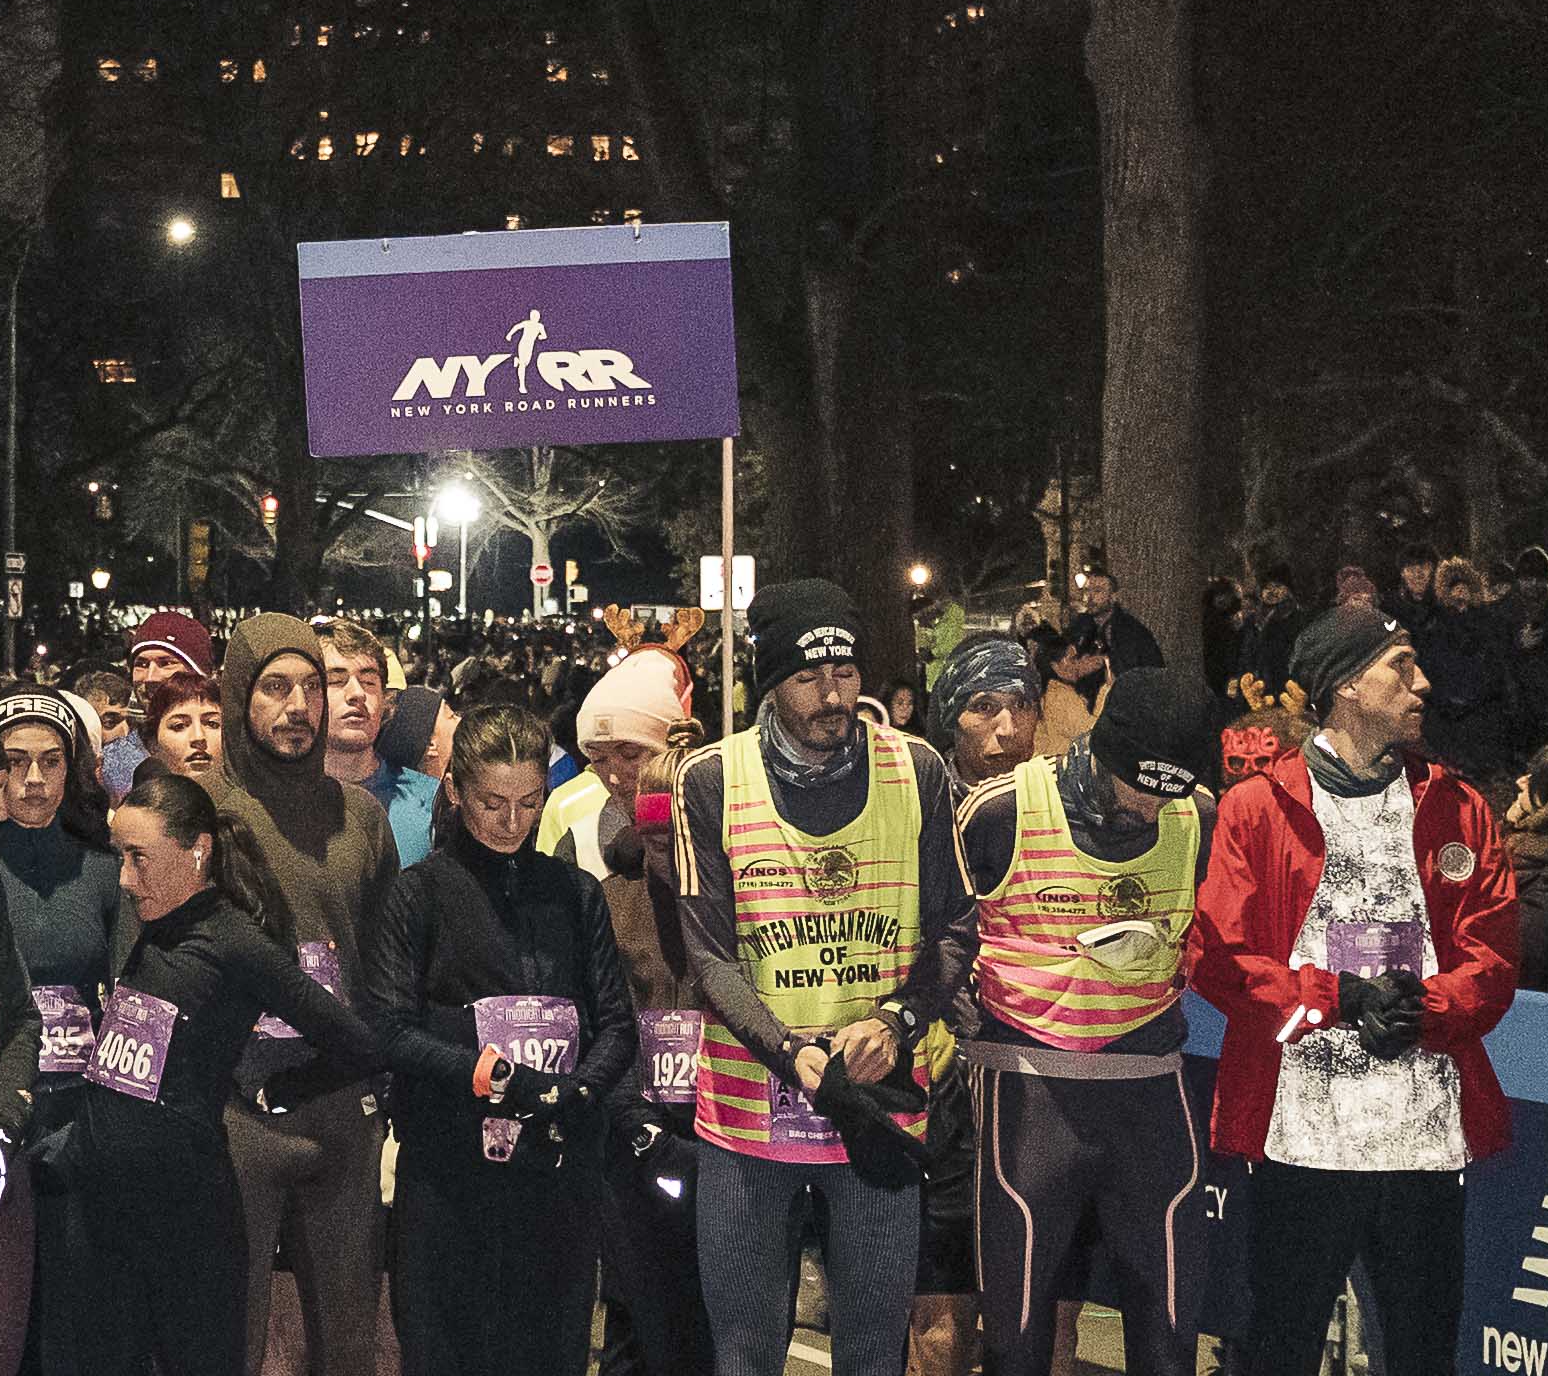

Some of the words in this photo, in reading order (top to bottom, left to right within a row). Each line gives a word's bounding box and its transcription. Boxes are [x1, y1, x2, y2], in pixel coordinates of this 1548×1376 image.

[392, 348, 654, 401] NYRR
[390, 404, 432, 419] NEW
[443, 401, 494, 416] YORK
[505, 397, 557, 412] ROAD
[567, 393, 657, 409] RUNNERS
[804, 646, 827, 660] NEW
[828, 645, 854, 657] YORK
[1136, 773, 1159, 788] NEW
[1160, 781, 1185, 793] YORK
[738, 866, 788, 880] XINOS
[792, 912, 856, 947] MEXICAN
[819, 946, 848, 966] OF
[775, 968, 824, 989] NEW
[831, 963, 882, 987] YORK
[97, 1029, 155, 1081] 4066
[509, 1038, 569, 1074] 1927
[789, 1129, 807, 1139] BAG
